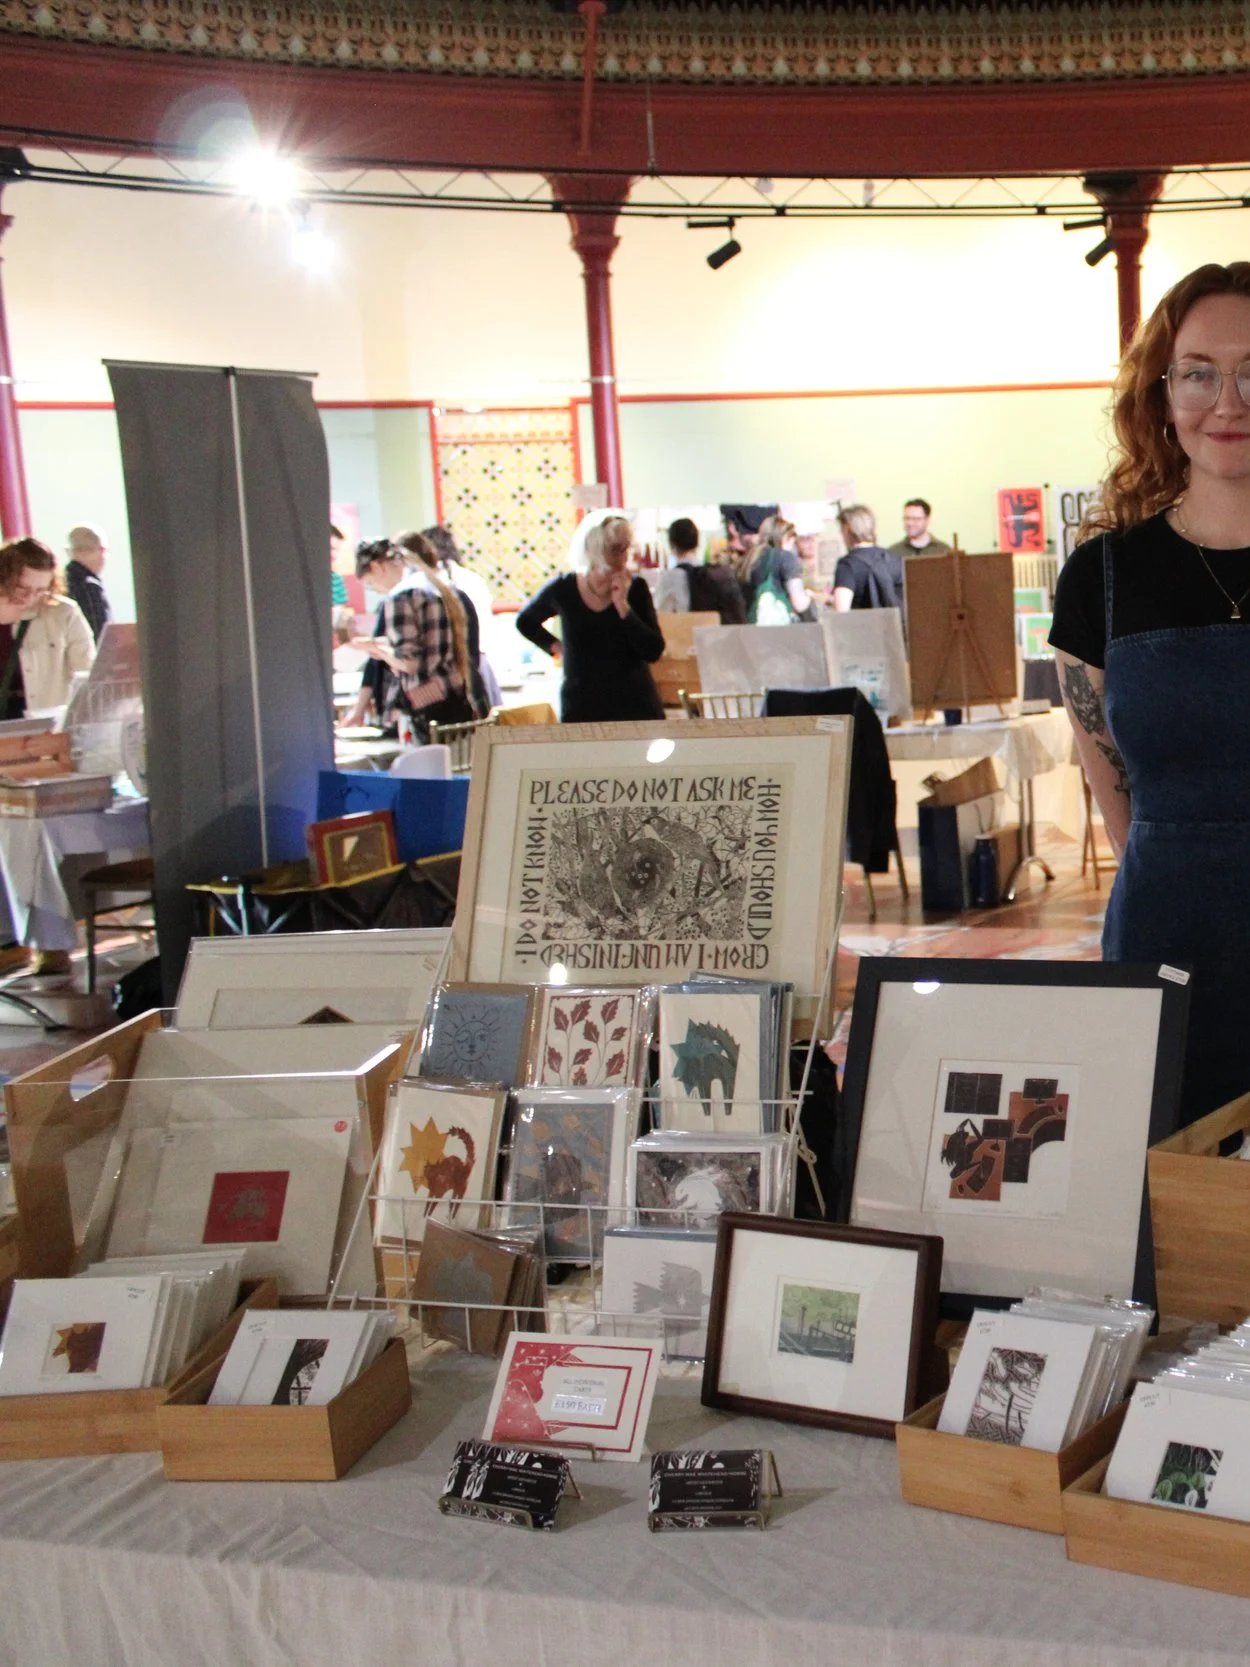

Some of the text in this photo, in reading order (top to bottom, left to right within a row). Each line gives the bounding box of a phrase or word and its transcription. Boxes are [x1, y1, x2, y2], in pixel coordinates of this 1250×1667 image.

[530, 776, 756, 804] PLEASE DO NOT ASK ME
[523, 817, 549, 869] KNOW
[747, 784, 781, 940] HOW YOU SHOULD
[519, 873, 544, 913] NOT
[515, 919, 538, 944] DO
[540, 943, 661, 969] UNFINISHED
[665, 943, 692, 968] AM
[713, 943, 769, 970] GROW
